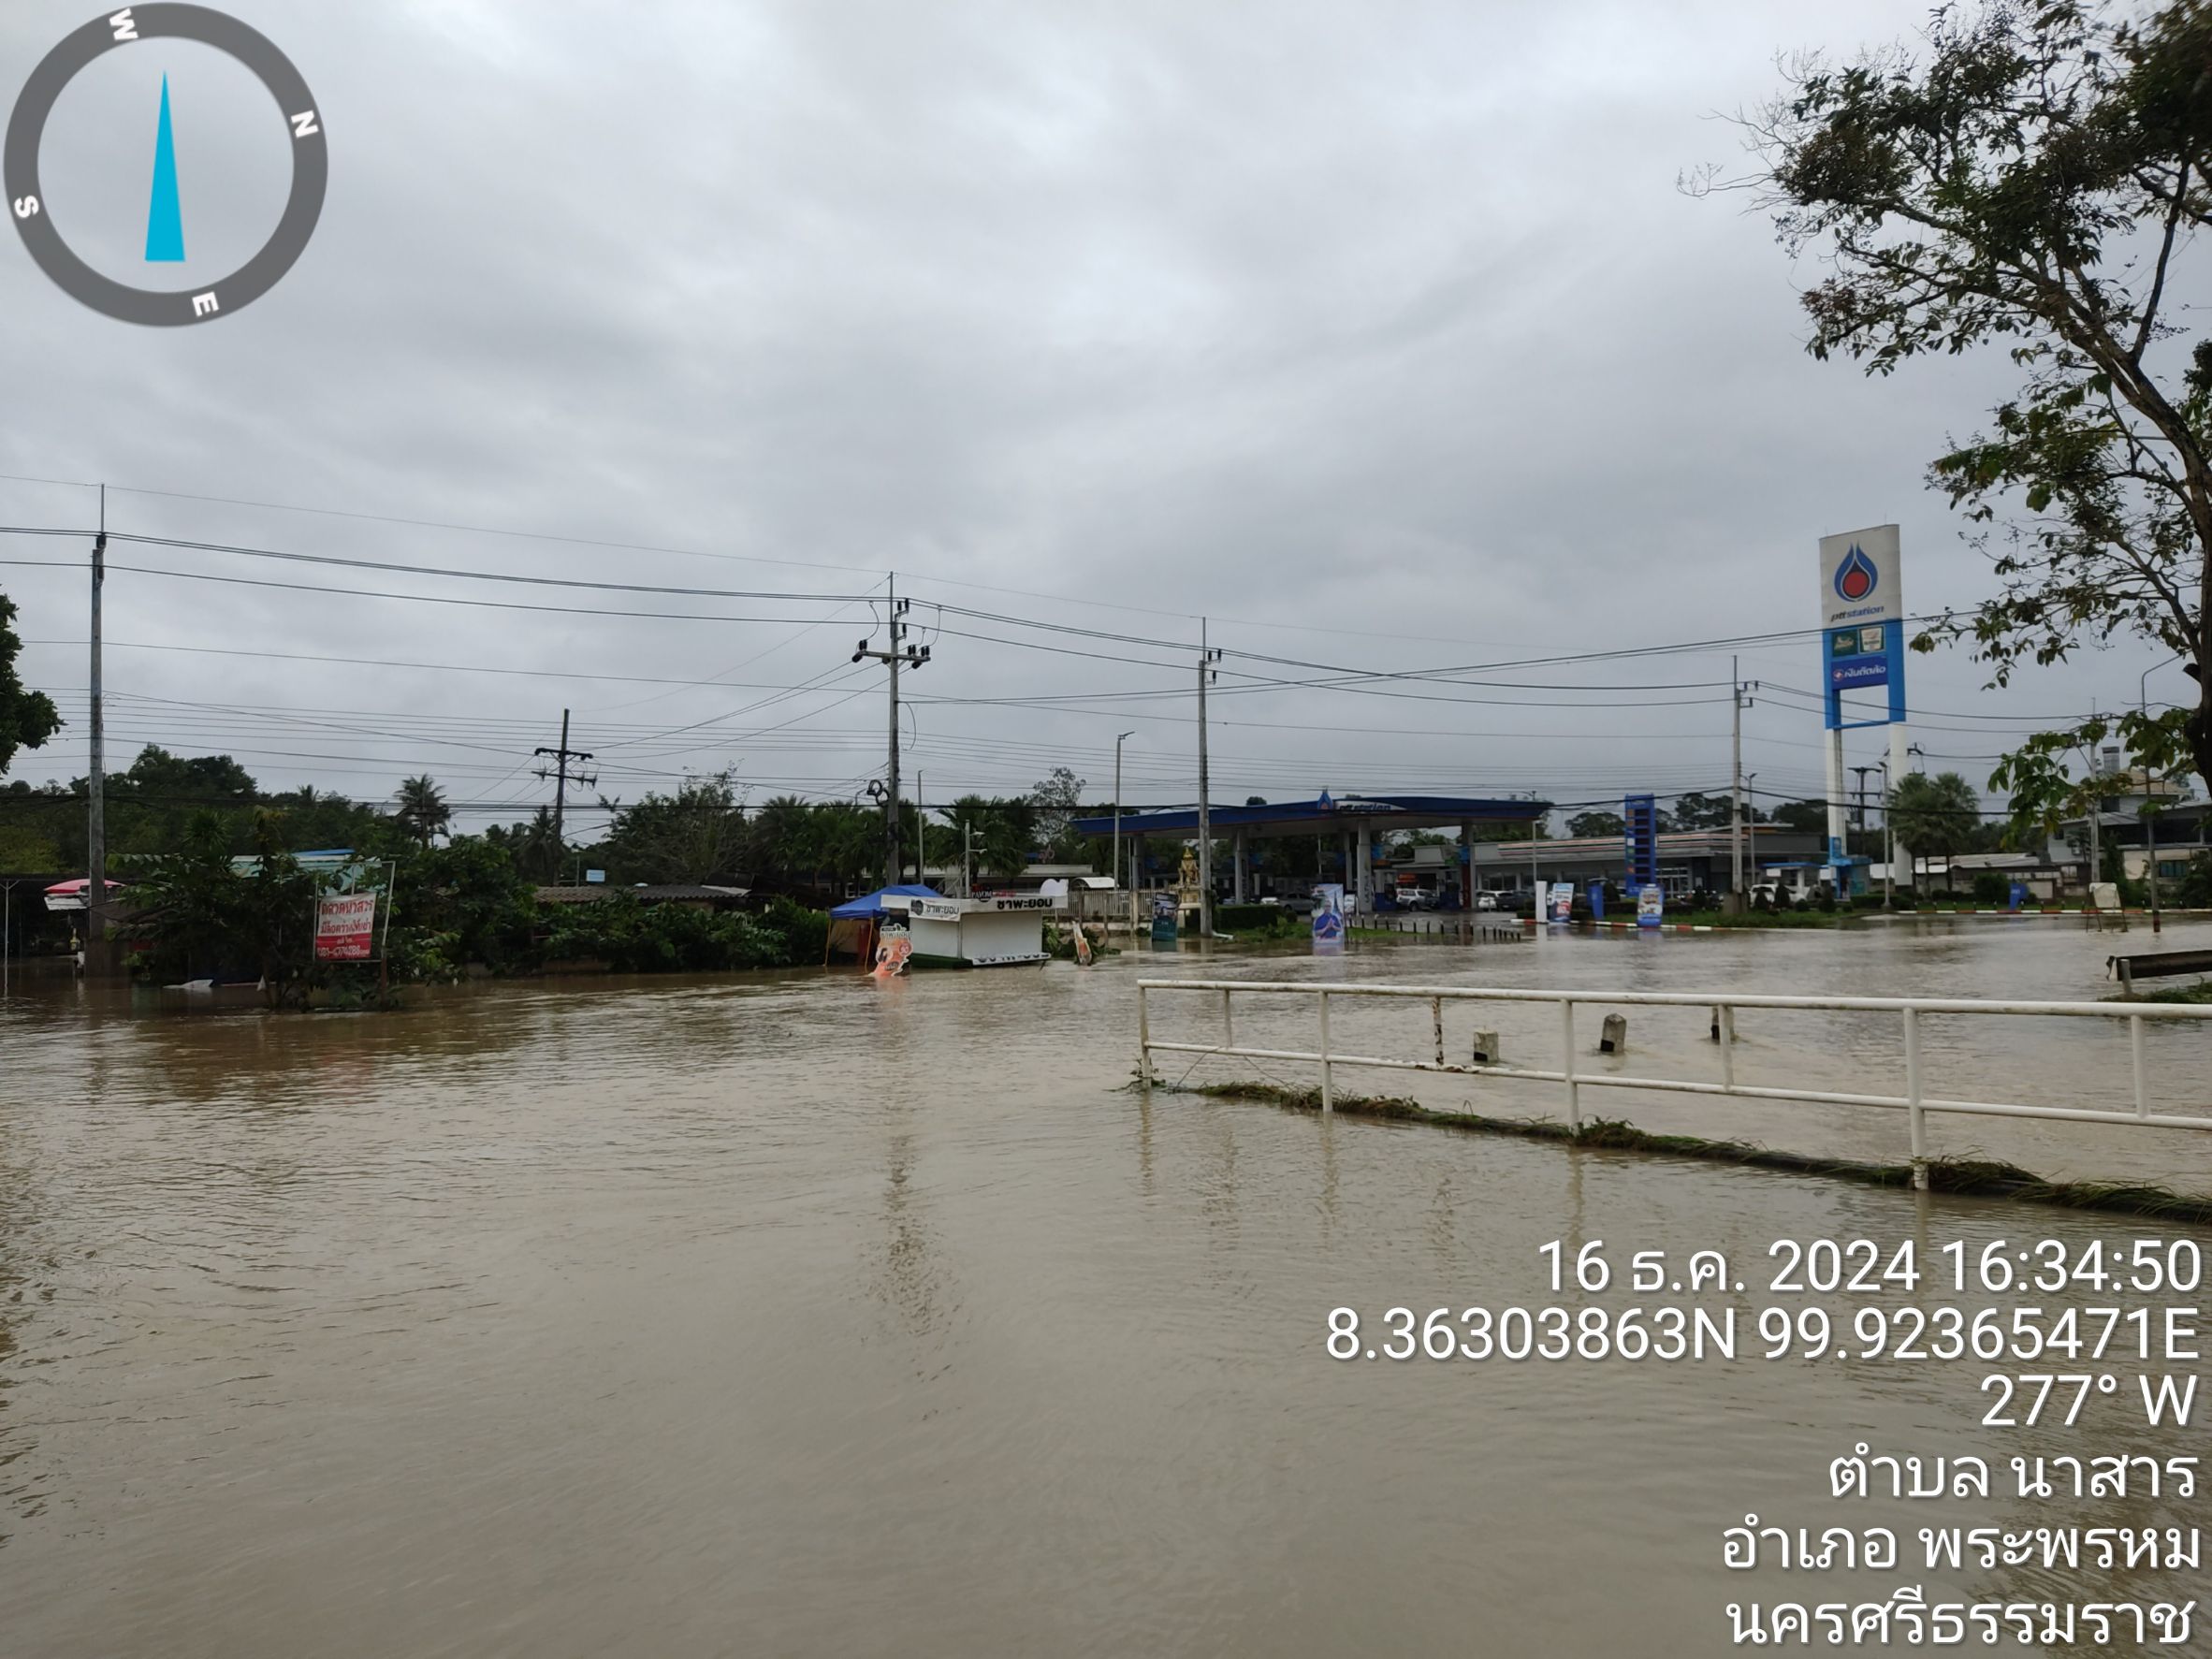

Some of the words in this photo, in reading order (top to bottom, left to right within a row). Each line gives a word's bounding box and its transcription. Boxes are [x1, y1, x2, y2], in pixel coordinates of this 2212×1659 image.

[926, 904, 960, 915] ชาพะยอม
[997, 898, 1054, 910] ชาพะยอม
